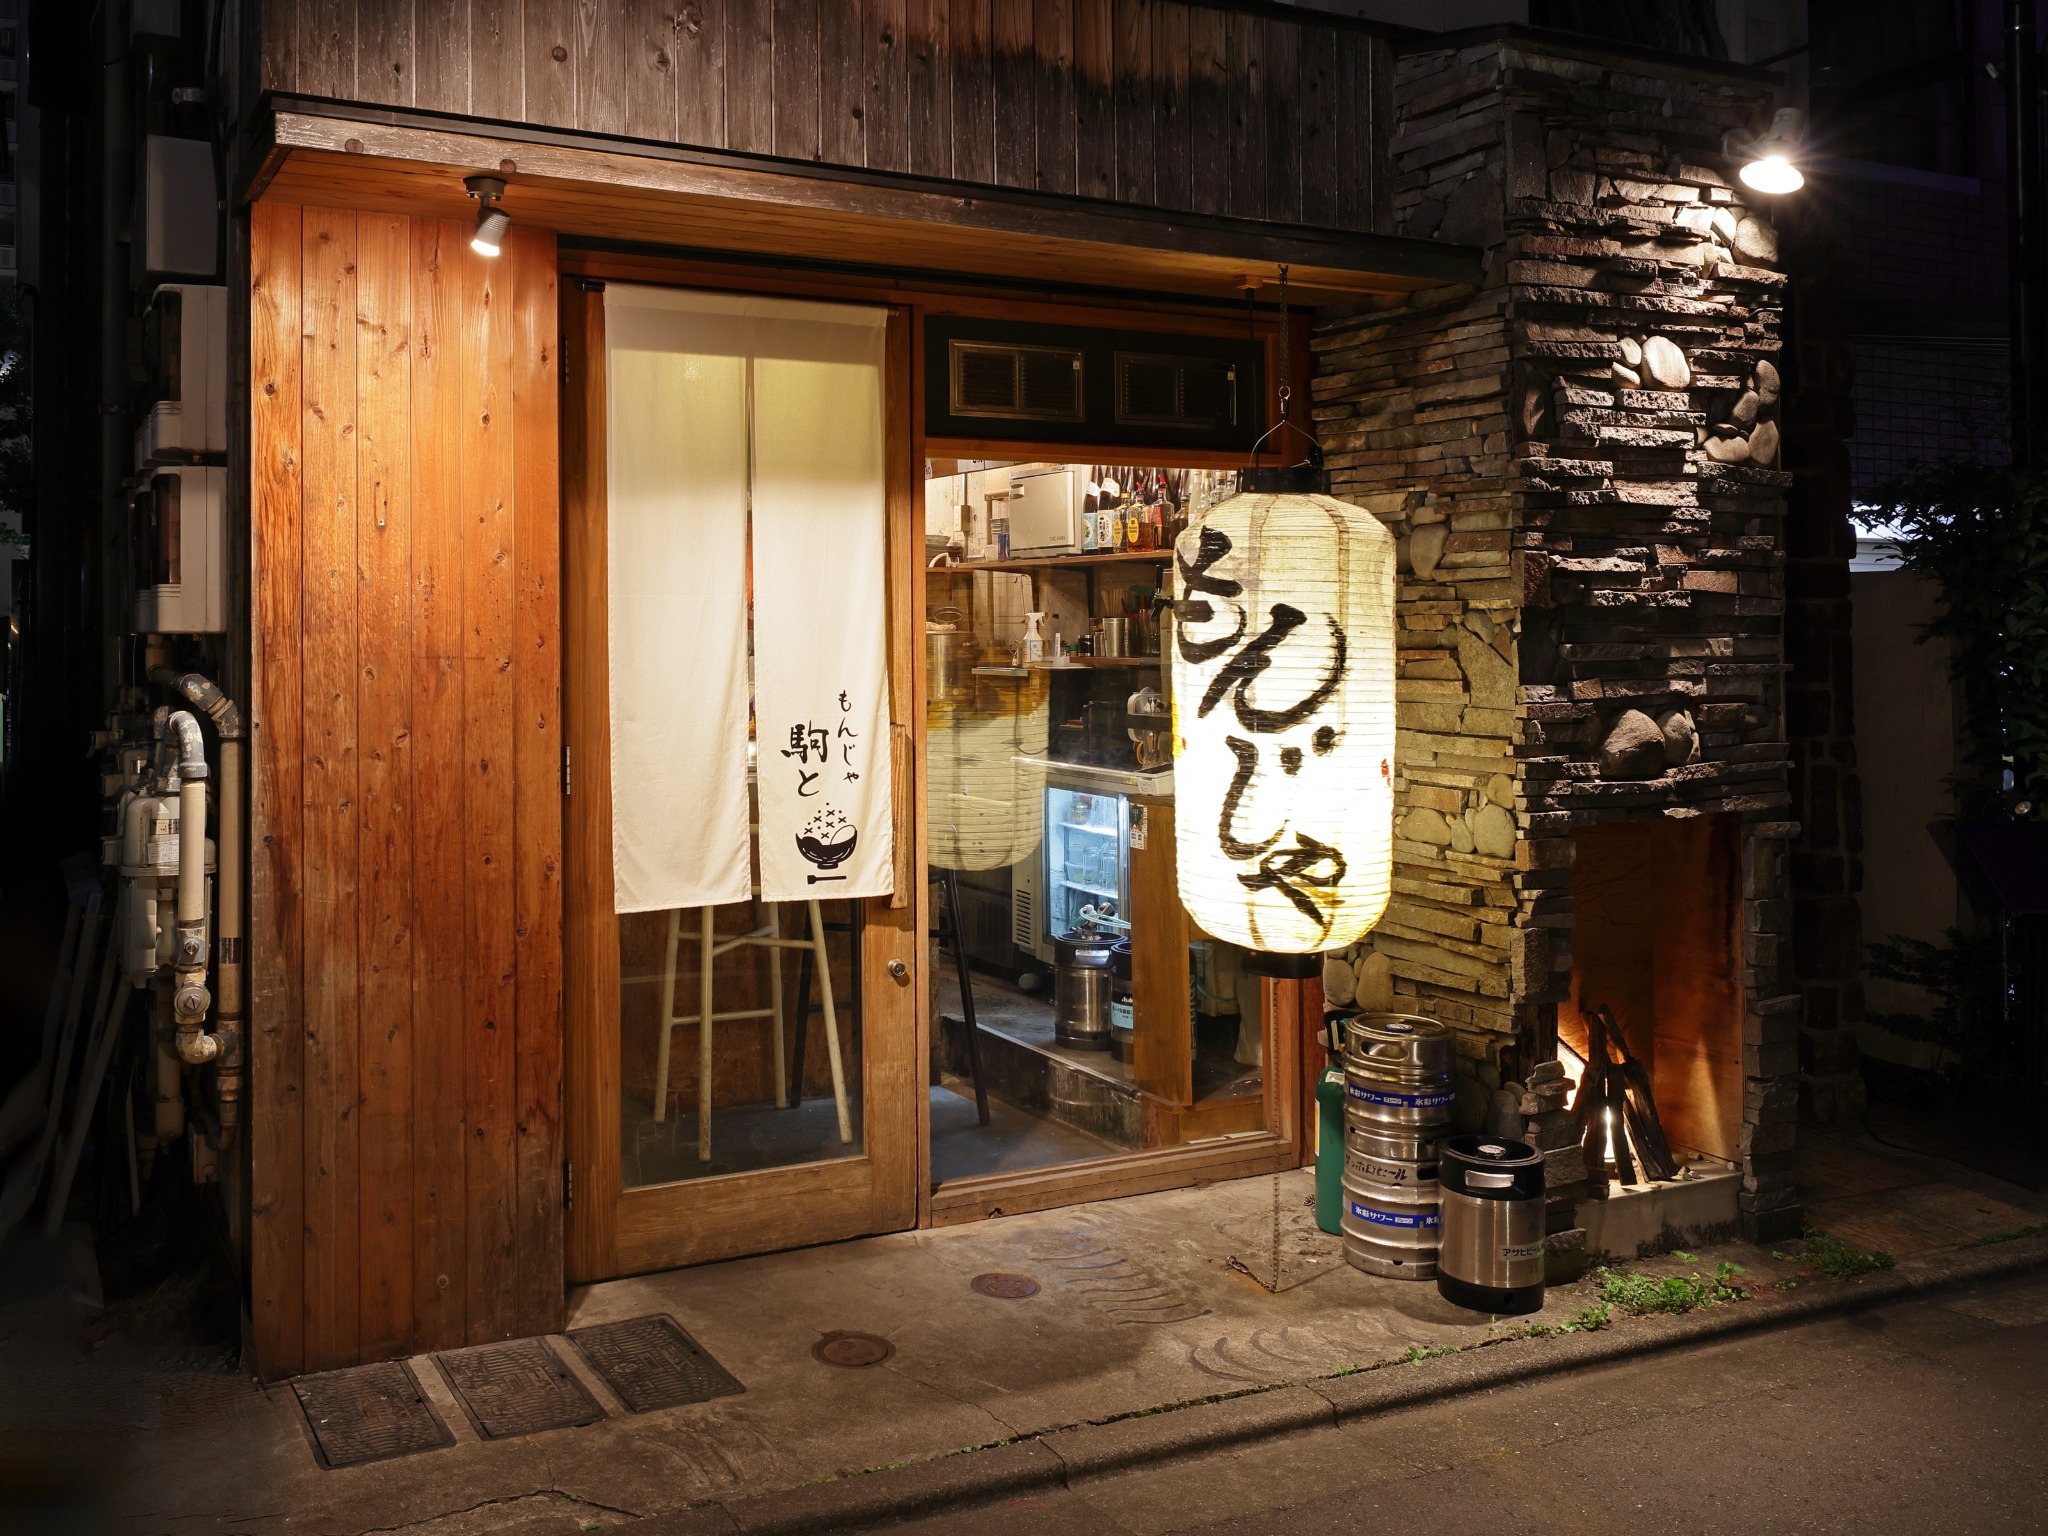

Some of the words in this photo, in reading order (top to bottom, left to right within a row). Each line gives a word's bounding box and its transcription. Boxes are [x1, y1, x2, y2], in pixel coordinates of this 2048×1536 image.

[781, 720, 829, 797] 駒と
[838, 690, 859, 783] もんじゃ
[1176, 526, 1348, 927] もんじゃ
